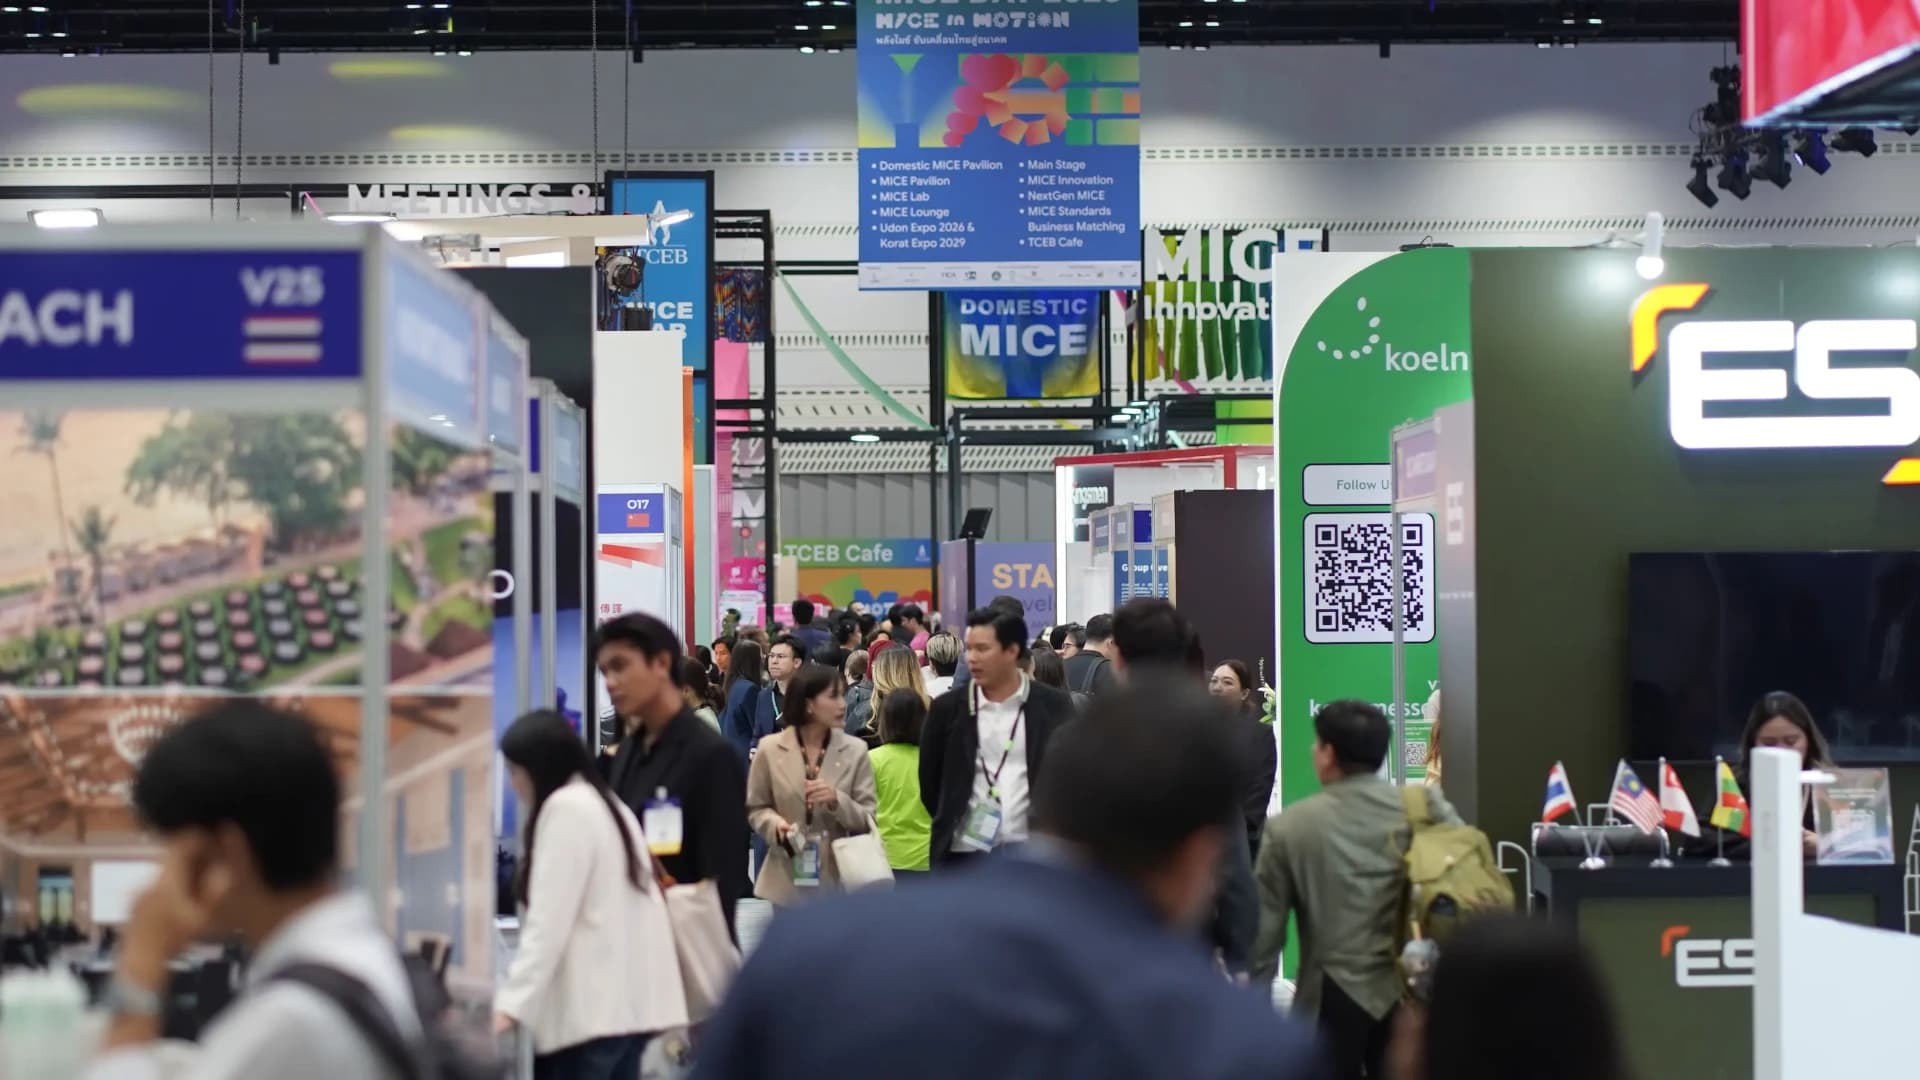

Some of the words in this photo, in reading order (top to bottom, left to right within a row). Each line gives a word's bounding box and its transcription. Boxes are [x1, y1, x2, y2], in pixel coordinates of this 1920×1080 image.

[880, 160, 931, 171] Domestic
[932, 160, 961, 170] MICE
[963, 160, 1003, 170] Pavilion
[1028, 160, 1053, 170] Main
[1055, 160, 1086, 172] Stage
[880, 176, 908, 186] MICE
[910, 176, 950, 186] Pavilion
[1028, 175, 1056, 185] MICE
[1058, 175, 1113, 185] Innovation
[348, 184, 550, 214] MEETINGS
[571, 184, 596, 214] &
[880, 192, 908, 201] MICE
[910, 192, 930, 202] Lab
[1028, 191, 1075, 201] NextGen
[1077, 190, 1105, 200] MICE
[880, 207, 908, 217] MICE
[910, 207, 949, 219] Lounge
[1028, 206, 1056, 216] MICE
[1058, 206, 1111, 216] Standards
[880, 222, 908, 233] Udon
[911, 222, 936, 235] Expo
[939, 222, 965, 232] 2026
[967, 222, 975, 232] &
[1028, 221, 1074, 232] Business
[1076, 221, 1125, 234] Matching
[880, 238, 909, 248] Korat
[911, 238, 937, 250] Expo
[940, 237, 966, 248] 2029
[1028, 237, 1056, 247] TCEB
[1058, 237, 1083, 247] Cafe
[960, 299, 1088, 316] DOMESTIC
[0, 292, 134, 345] ACH
[960, 324, 1088, 356] MICE
[1385, 343, 1469, 371] koeln
[1336, 479, 1377, 490] Follow
[783, 544, 839, 562] TCEB
[845, 543, 893, 562] Cafe
[992, 563, 1054, 589] STA
